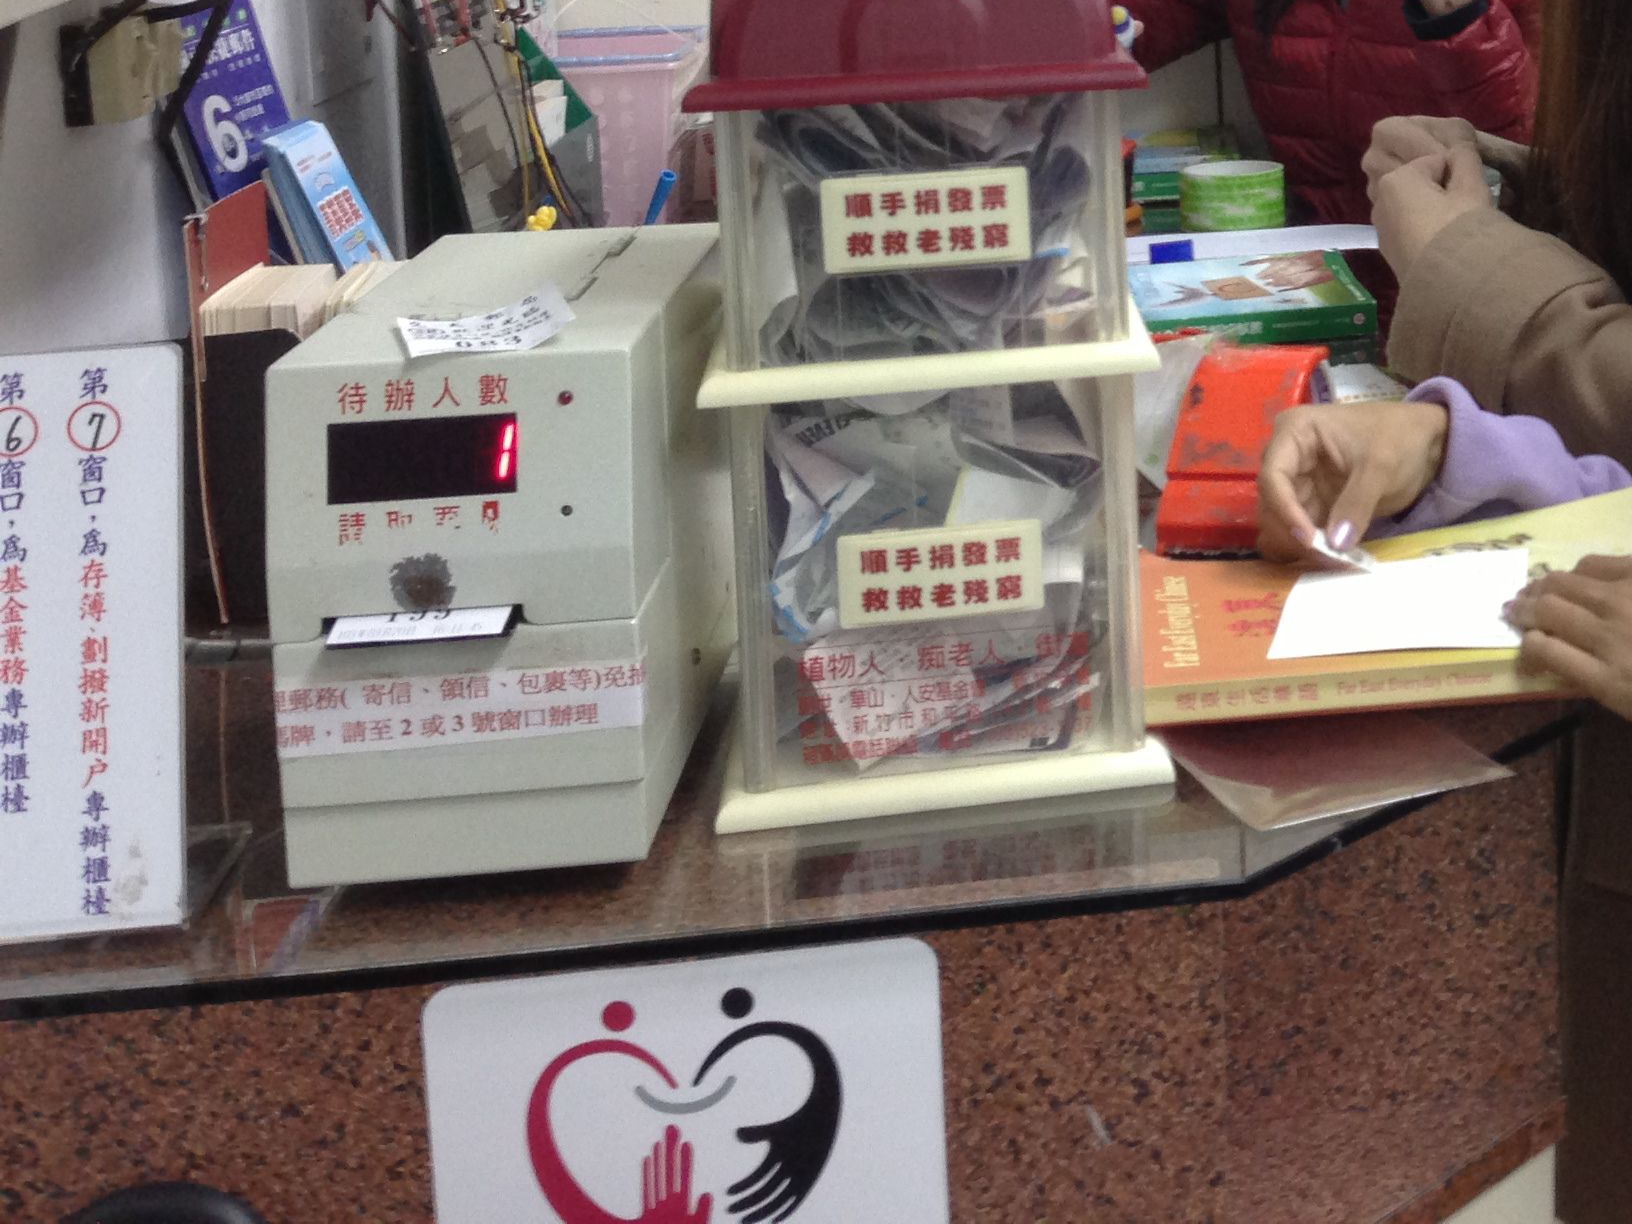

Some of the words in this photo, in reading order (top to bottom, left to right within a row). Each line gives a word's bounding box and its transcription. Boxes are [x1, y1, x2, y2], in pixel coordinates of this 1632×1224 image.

[844, 184, 1007, 219] 順手捐發票
[337, 373, 509, 416] 待辦人數
[498, 421, 516, 480] 1
[860, 537, 1022, 576] 順手捐發票
